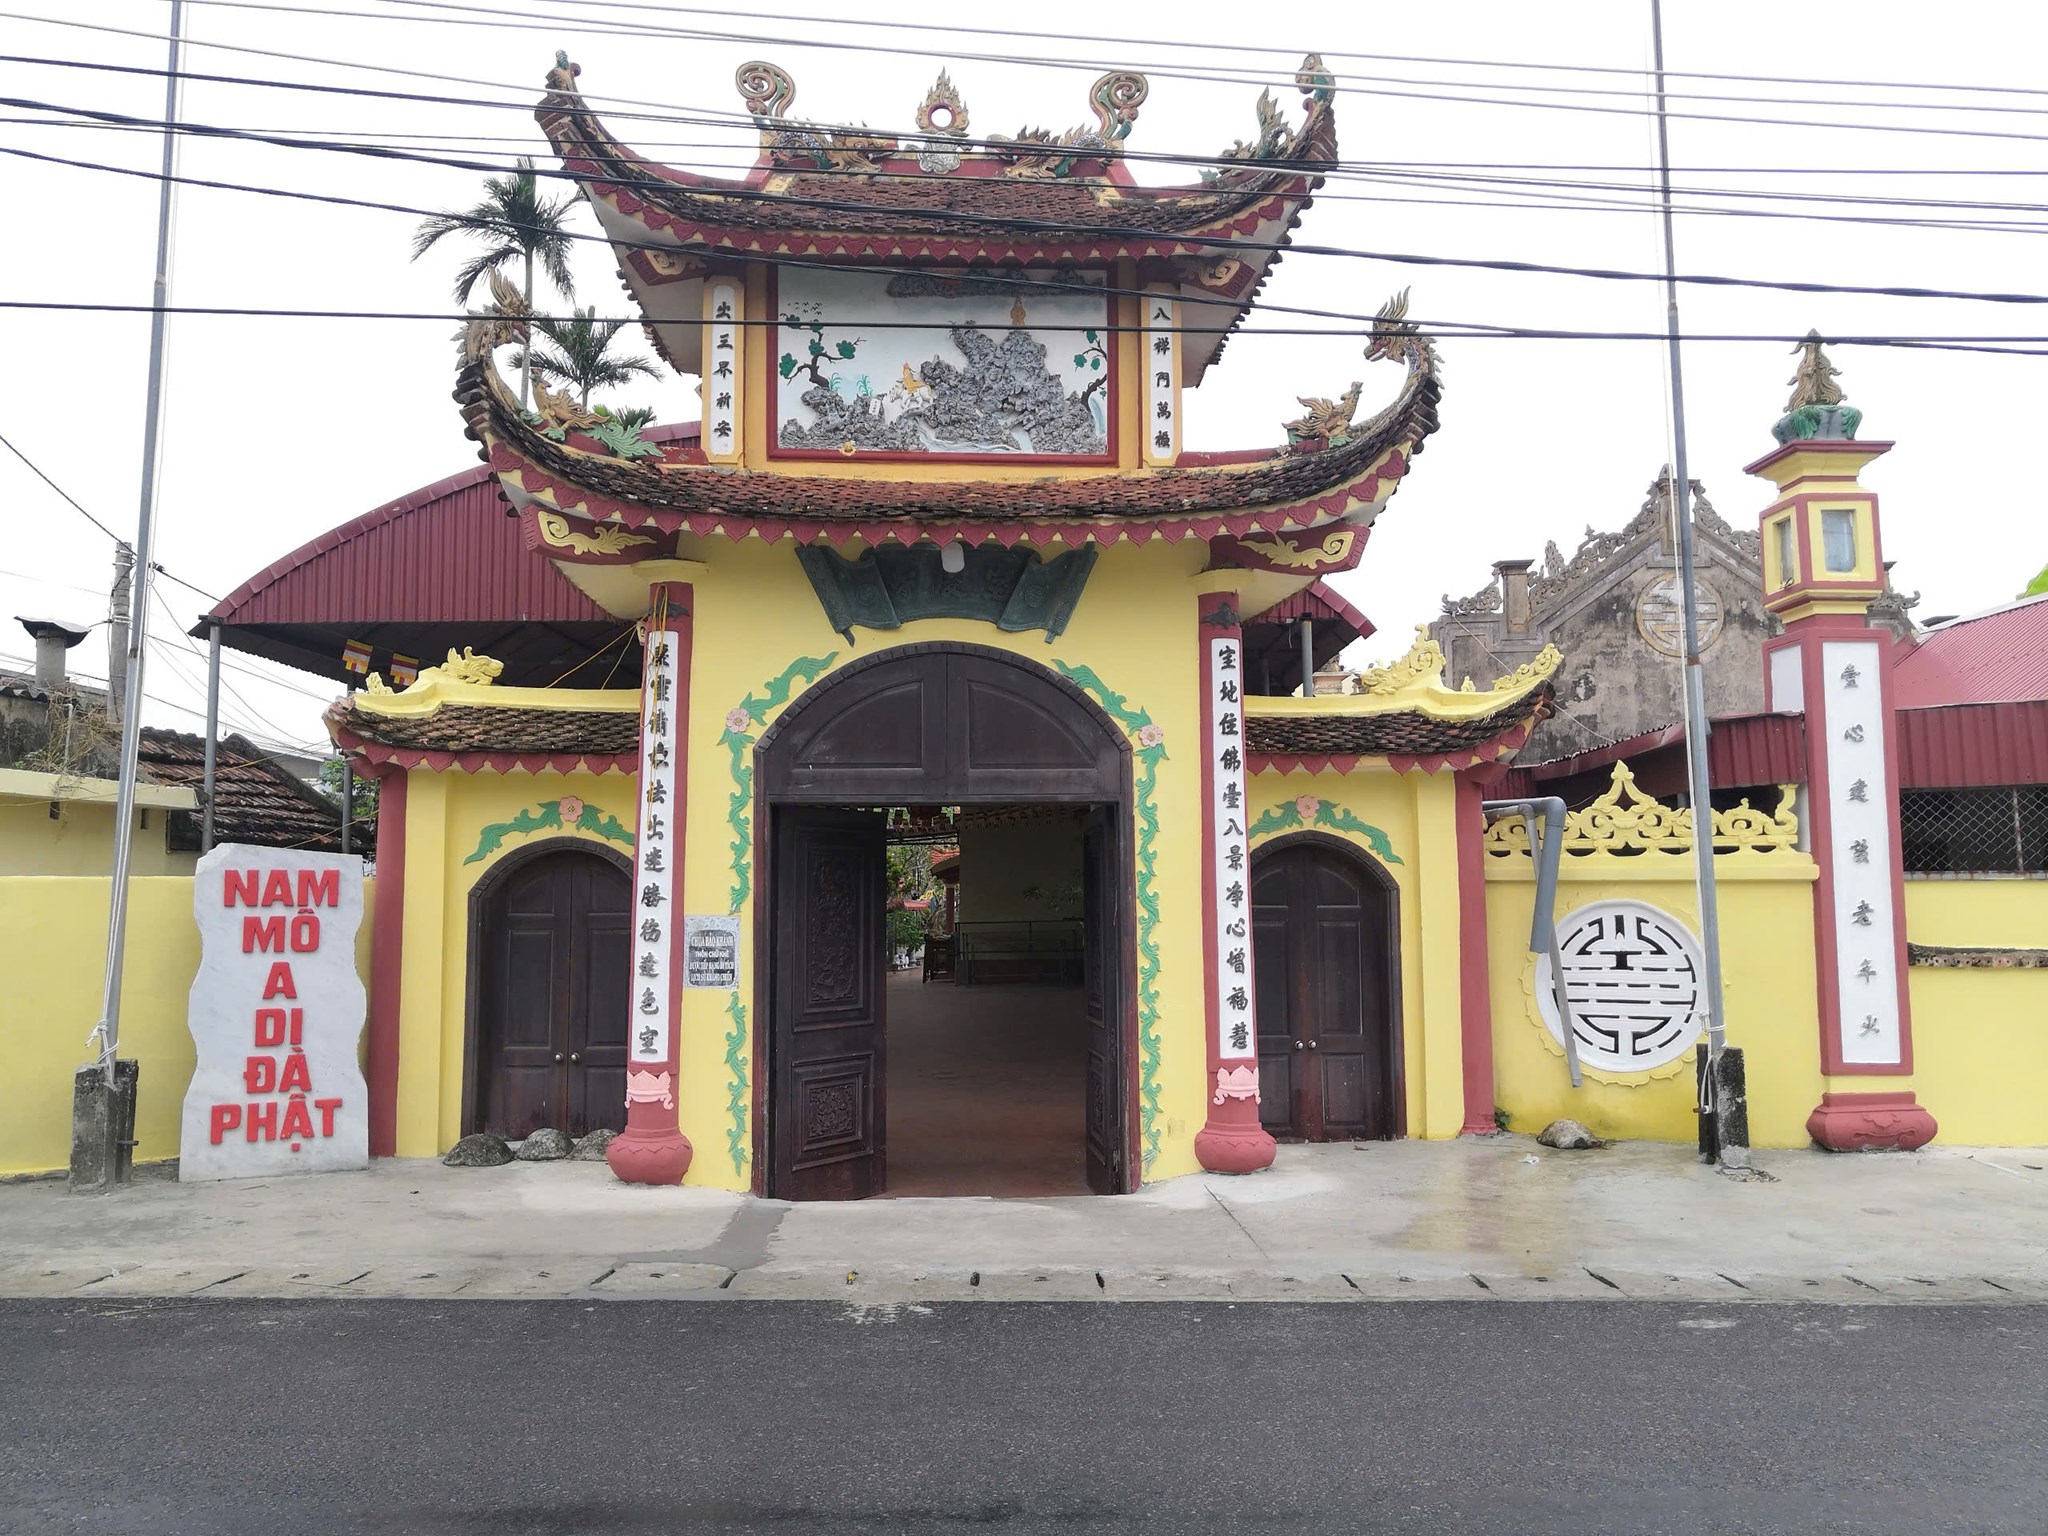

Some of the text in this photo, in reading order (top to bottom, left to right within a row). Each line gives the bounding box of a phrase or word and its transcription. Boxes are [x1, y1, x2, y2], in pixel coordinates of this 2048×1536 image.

[223, 869, 340, 907] NAM
[242, 907, 321, 953] MÔ
[262, 961, 298, 1000] A
[254, 1007, 303, 1047] DI
[243, 1046, 312, 1094] ĐÀ
[210, 1093, 343, 1152] PHẬT
